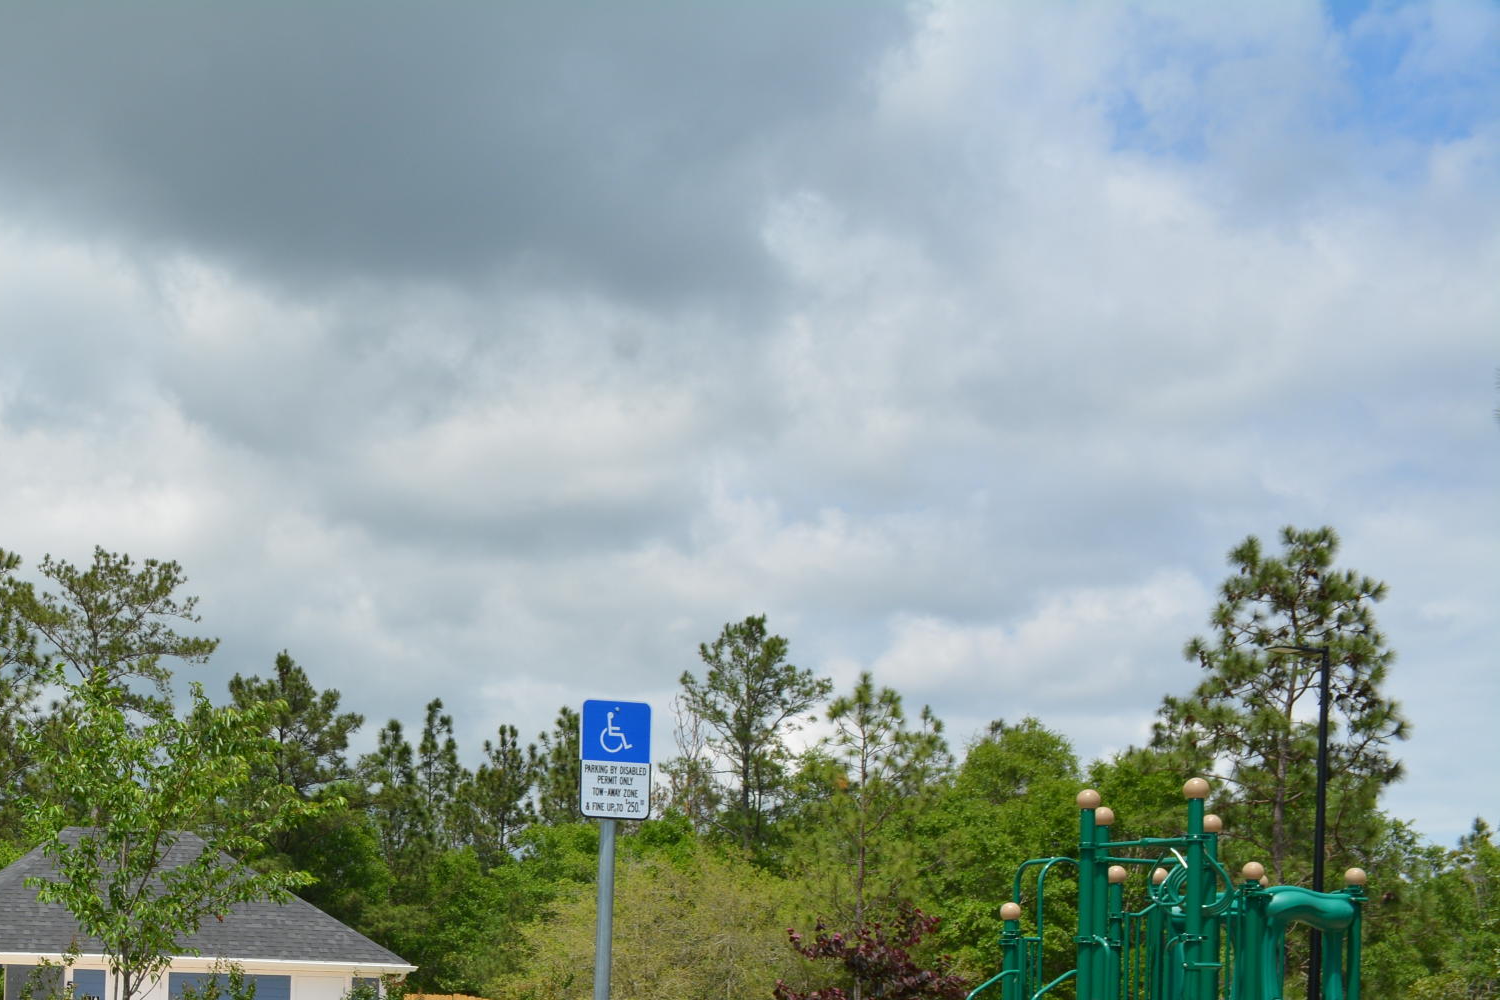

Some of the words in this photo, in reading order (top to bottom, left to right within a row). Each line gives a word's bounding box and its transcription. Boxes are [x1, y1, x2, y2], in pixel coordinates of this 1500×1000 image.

[584, 764, 608, 774] PARKING
[610, 765, 617, 774] BY
[620, 766, 646, 775] DISABLED
[597, 775, 617, 784] PERMIT
[620, 776, 633, 785] ONLY
[592, 787, 621, 797] TOW-AWAY
[623, 789, 638, 798] ZONE
[585, 802, 590, 810] &
[592, 802, 604, 811] FINE
[607, 803, 615, 811] UP
[616, 803, 623, 812] TO
